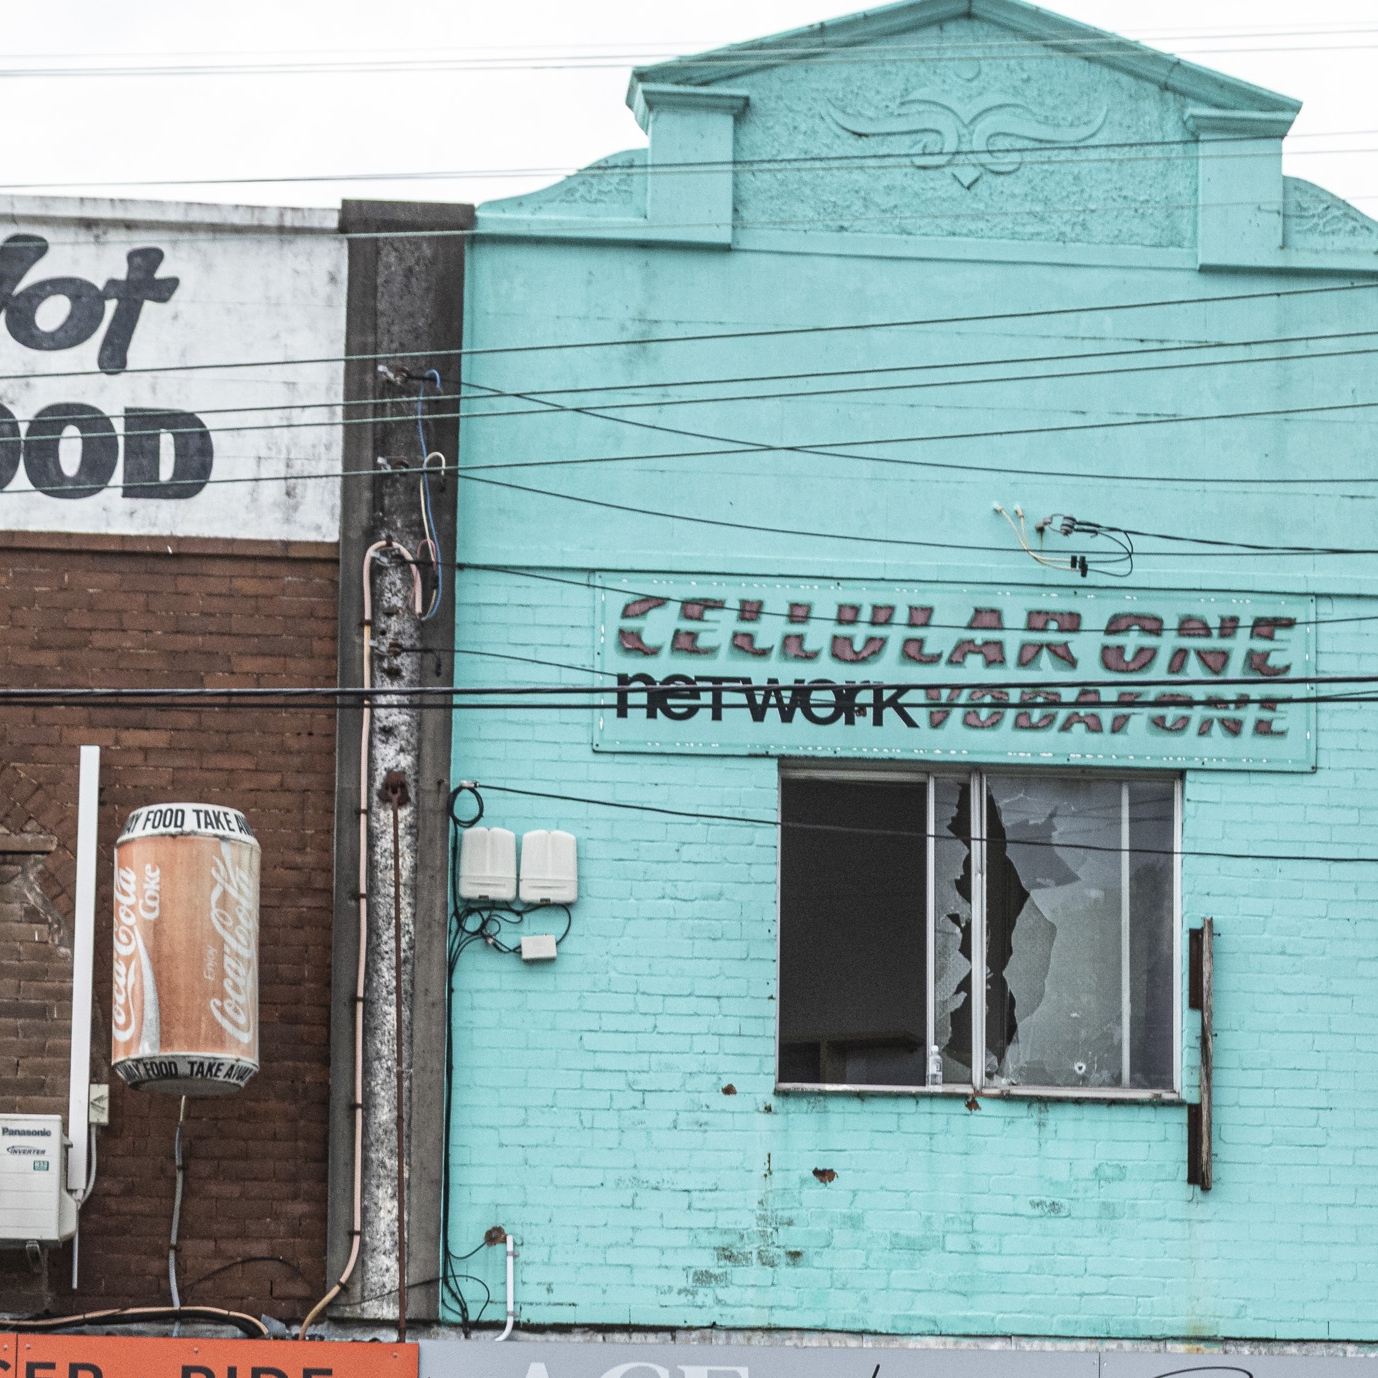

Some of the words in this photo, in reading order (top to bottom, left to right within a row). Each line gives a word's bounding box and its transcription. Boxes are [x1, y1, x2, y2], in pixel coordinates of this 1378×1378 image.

[618, 597, 1082, 672] CELLULAR
[1098, 612, 1297, 676] ONE
[142, 808, 185, 831] FOOD
[192, 808, 235, 832] TAKE
[138, 863, 161, 921] Coke
[142, 1061, 178, 1080] FOOD
[188, 1061, 224, 1078] TAKE
[2, 1127, 51, 1136] Panasonic
